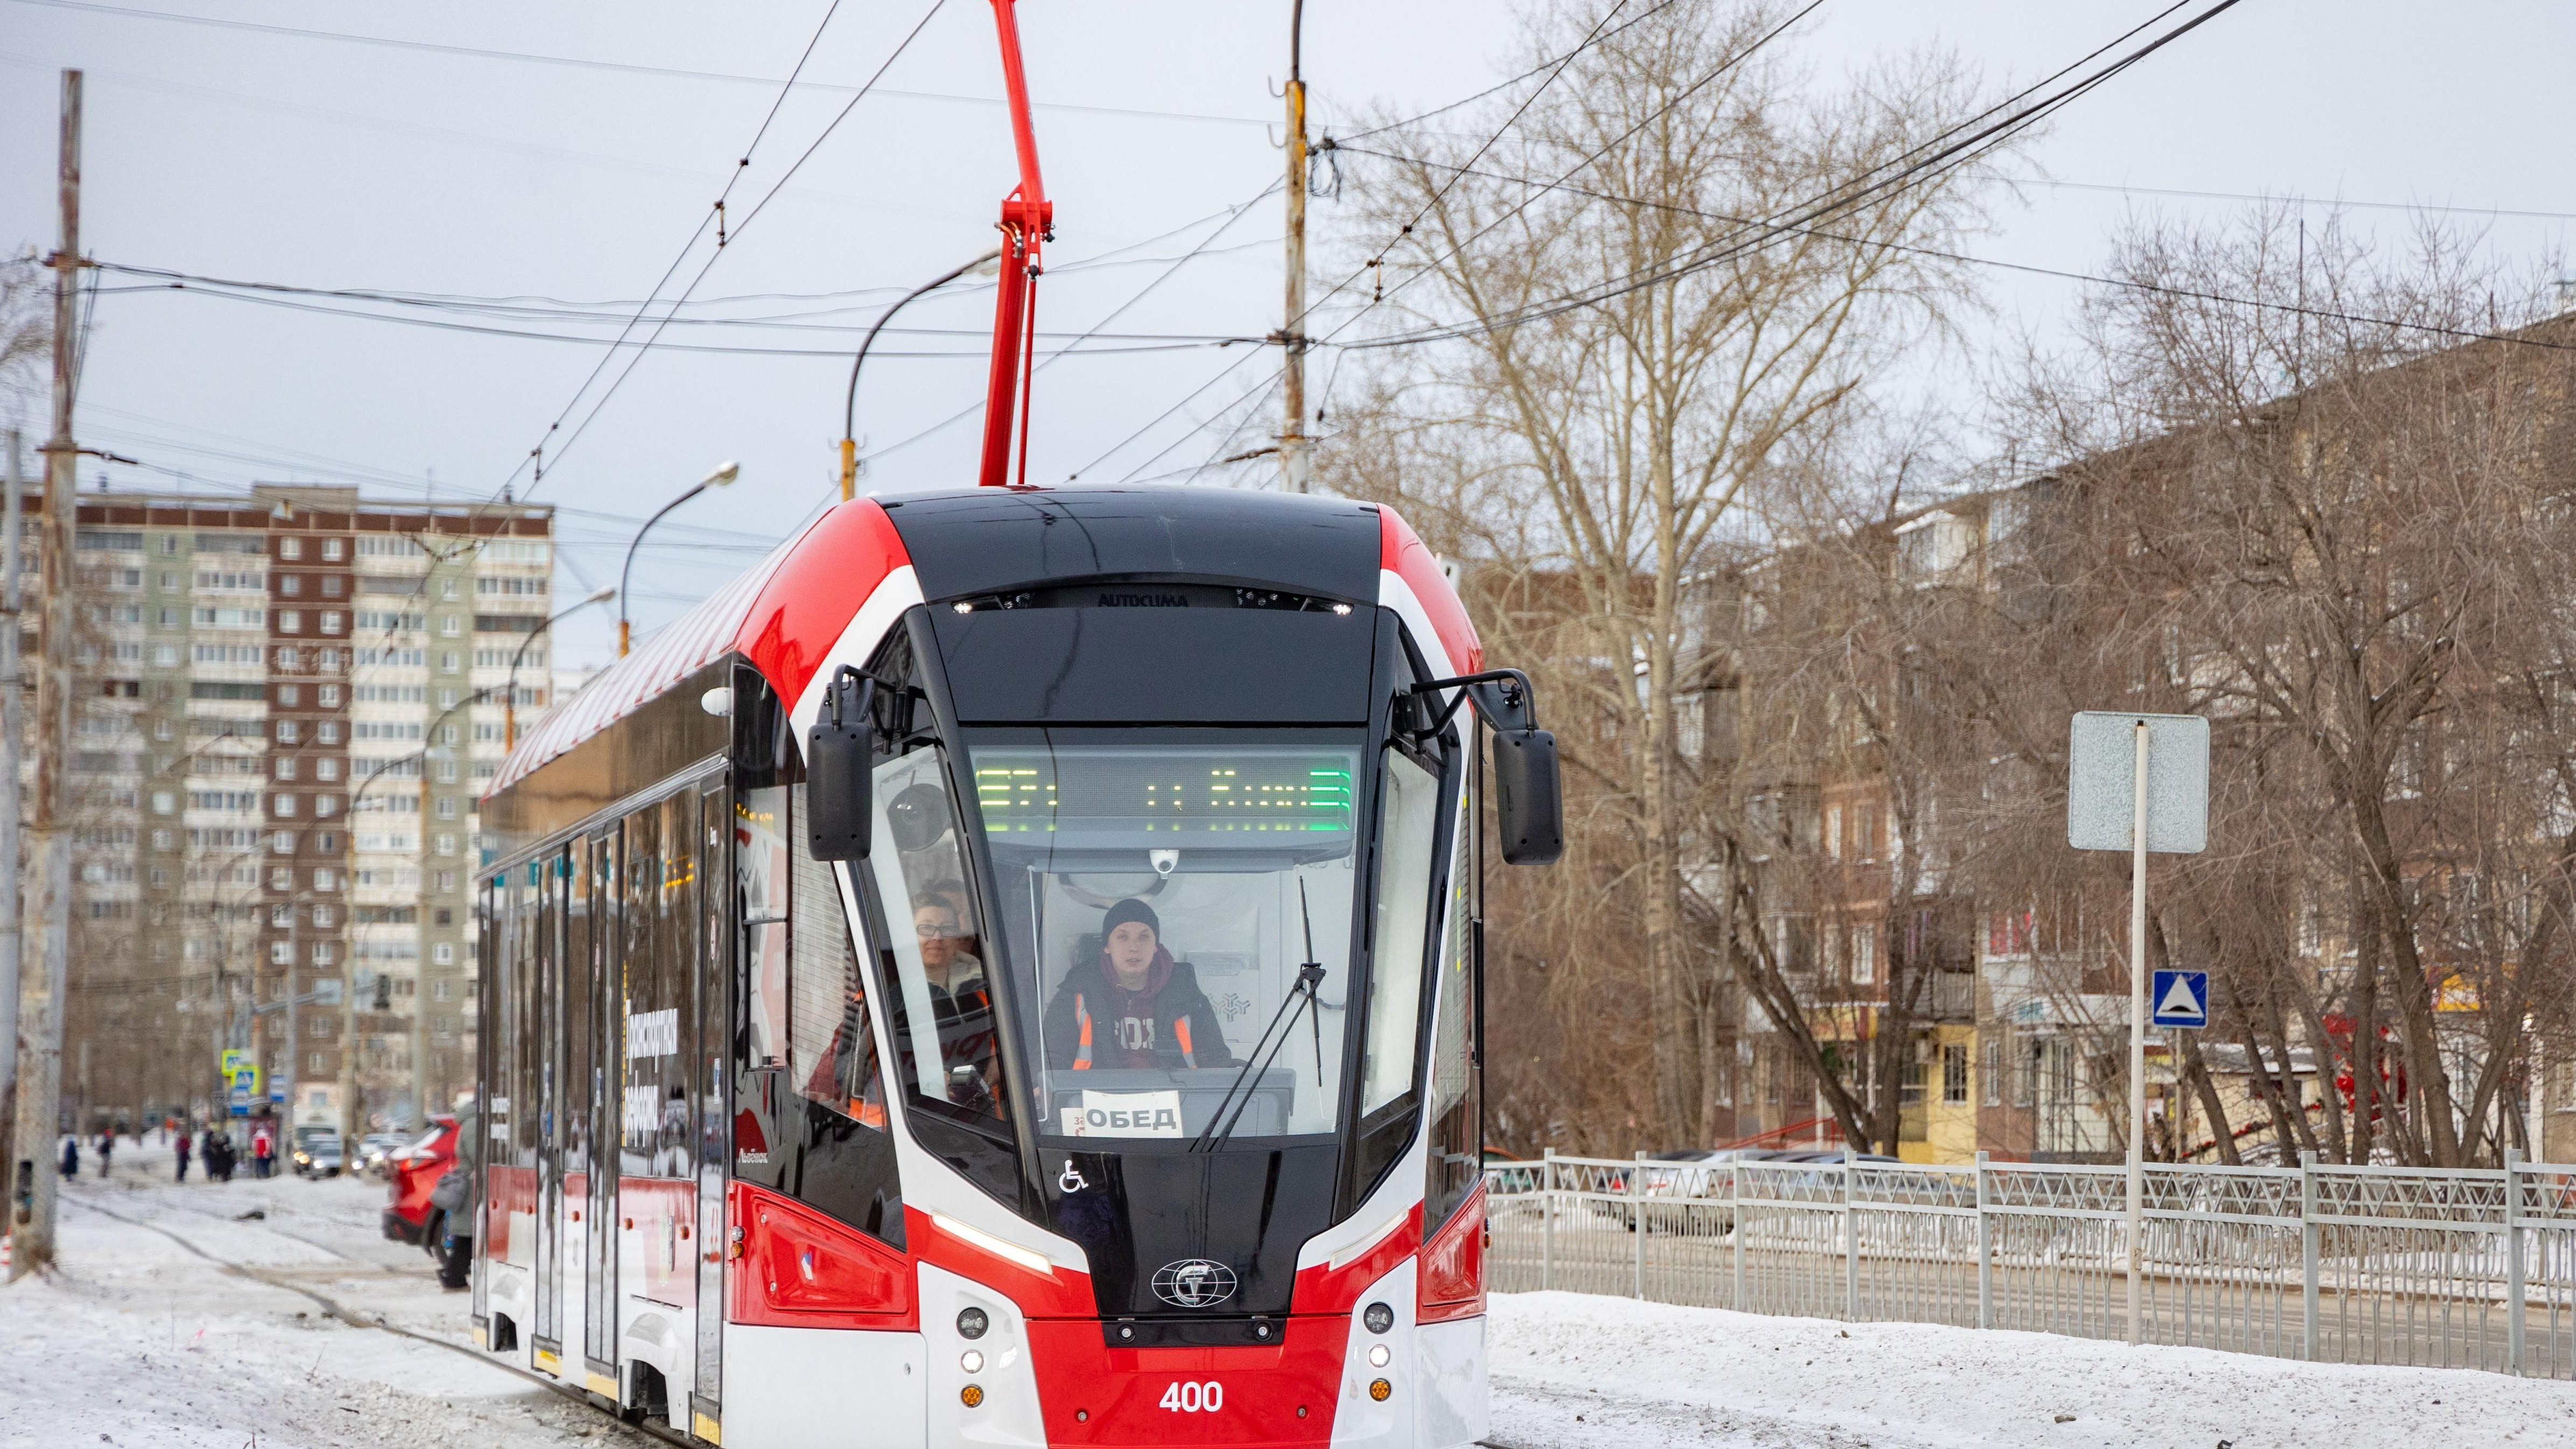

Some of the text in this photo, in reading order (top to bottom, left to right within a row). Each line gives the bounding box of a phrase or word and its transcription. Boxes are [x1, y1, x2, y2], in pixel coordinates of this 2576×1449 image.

[1098, 593, 1189, 607] AUTOCLIMA
[625, 998, 678, 1075] Транспортная
[624, 1070, 658, 1147] реформа
[1086, 1108, 1177, 1130] ОБЕД
[1159, 1381, 1223, 1412] 400
